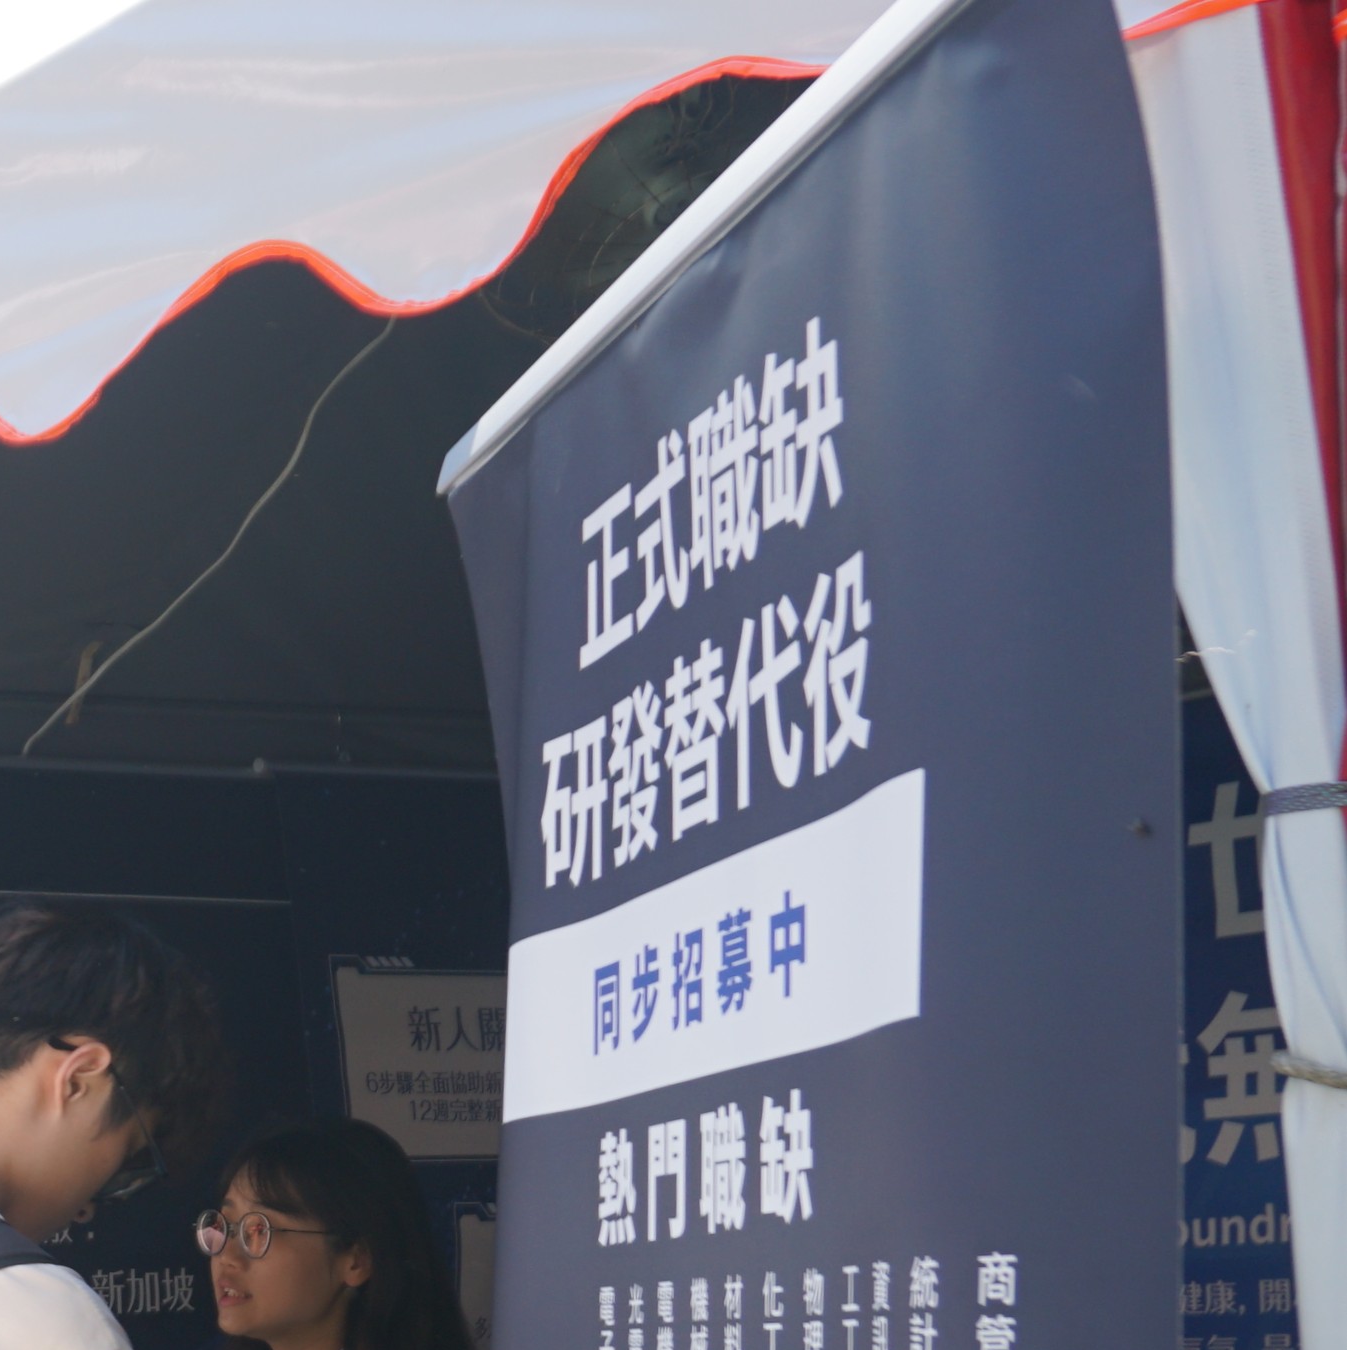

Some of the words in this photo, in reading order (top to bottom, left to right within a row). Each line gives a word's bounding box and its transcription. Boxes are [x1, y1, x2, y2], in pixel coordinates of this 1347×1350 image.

[579, 316, 843, 670] 正式職缺
[540, 551, 872, 889] 研發替代役
[593, 890, 808, 1056] 同步招募中
[1179, 990, 1287, 1167] 無
[597, 1088, 815, 1248] 熱門職缺
[92, 1266, 195, 1314] 新加坡
